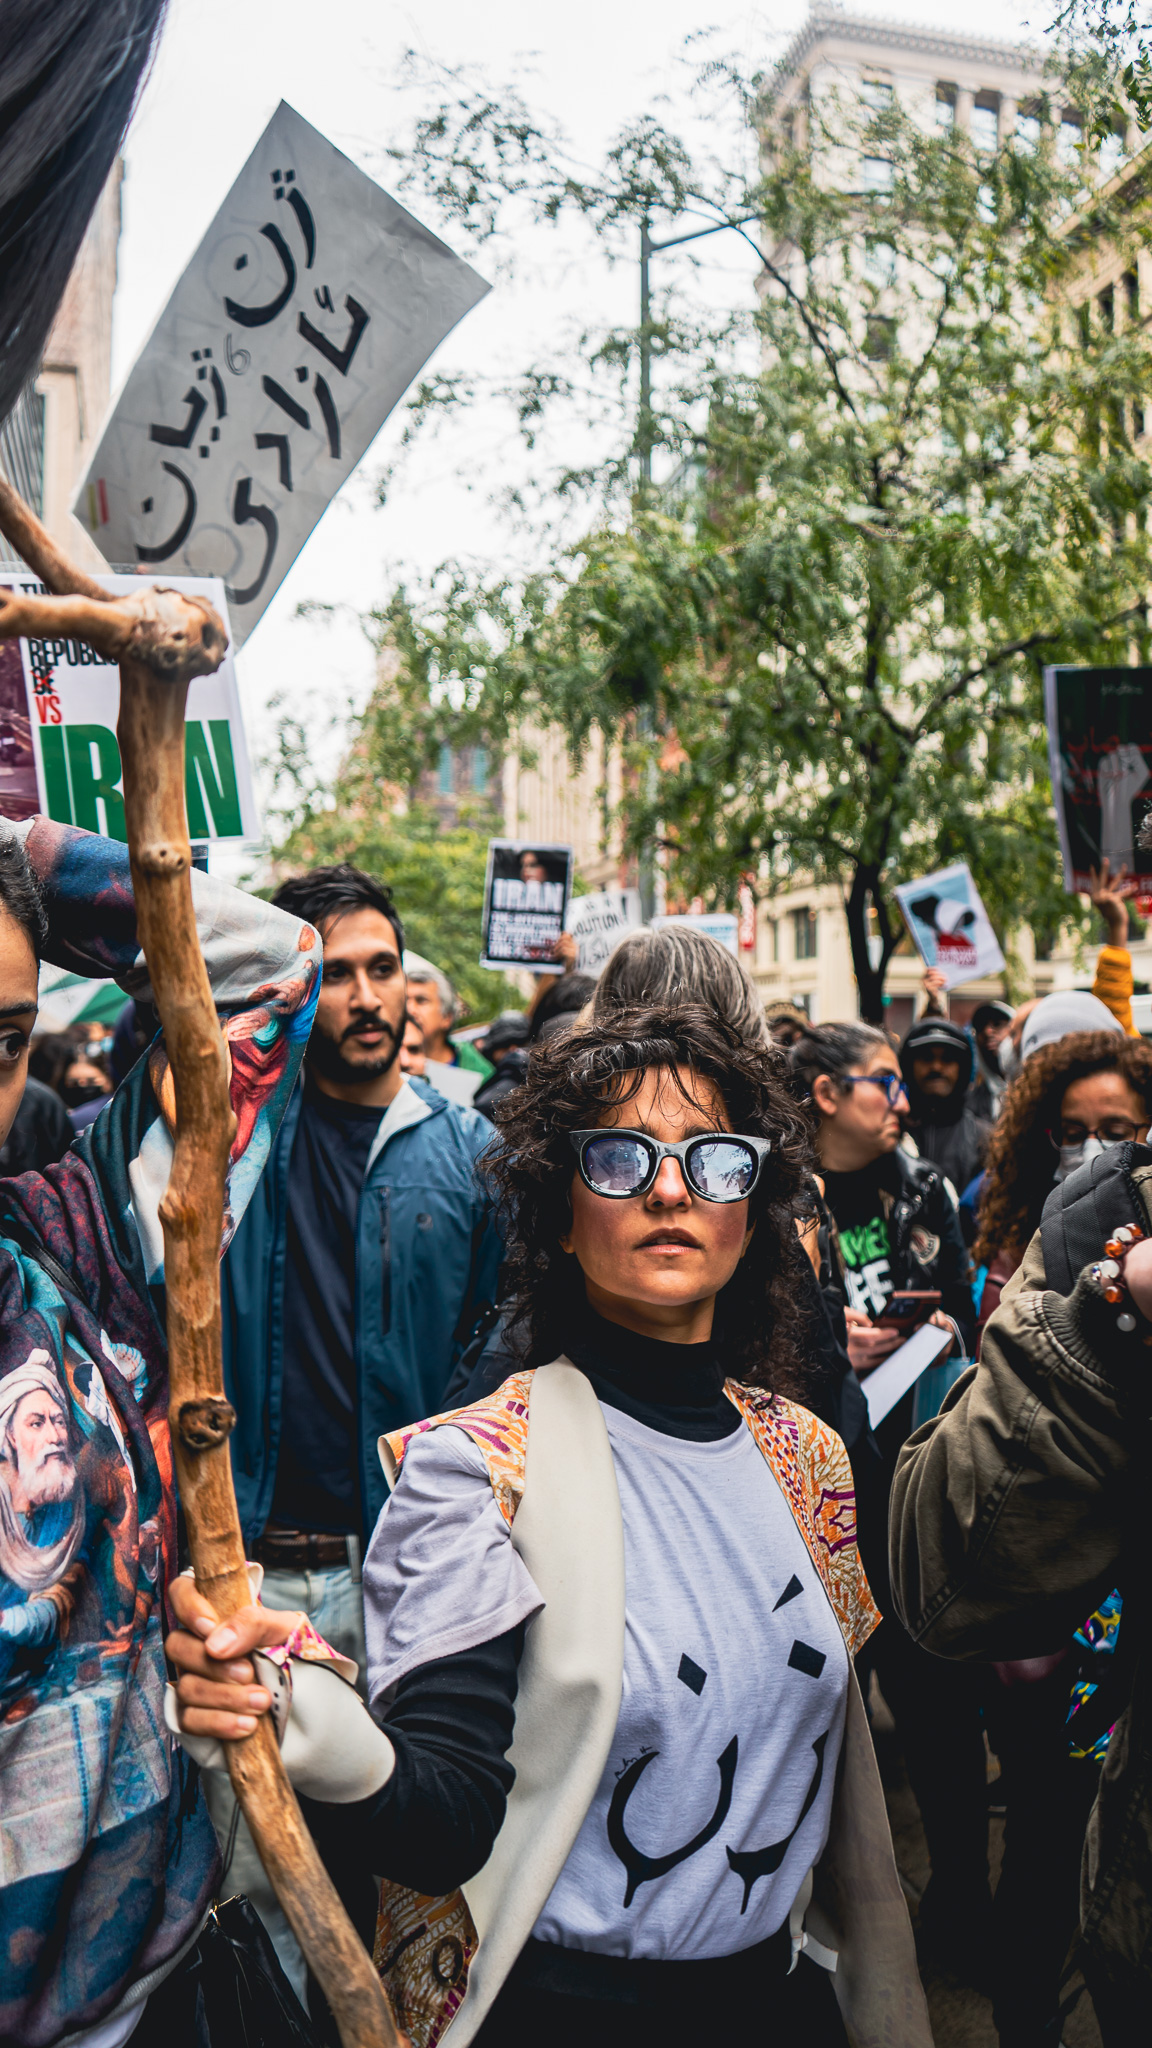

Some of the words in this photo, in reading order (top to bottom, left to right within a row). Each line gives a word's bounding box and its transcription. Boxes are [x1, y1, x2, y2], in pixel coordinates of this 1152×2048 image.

[35, 695, 62, 724] VS
[39, 719, 244, 843] IRN
[493, 878, 565, 913] IRAN
